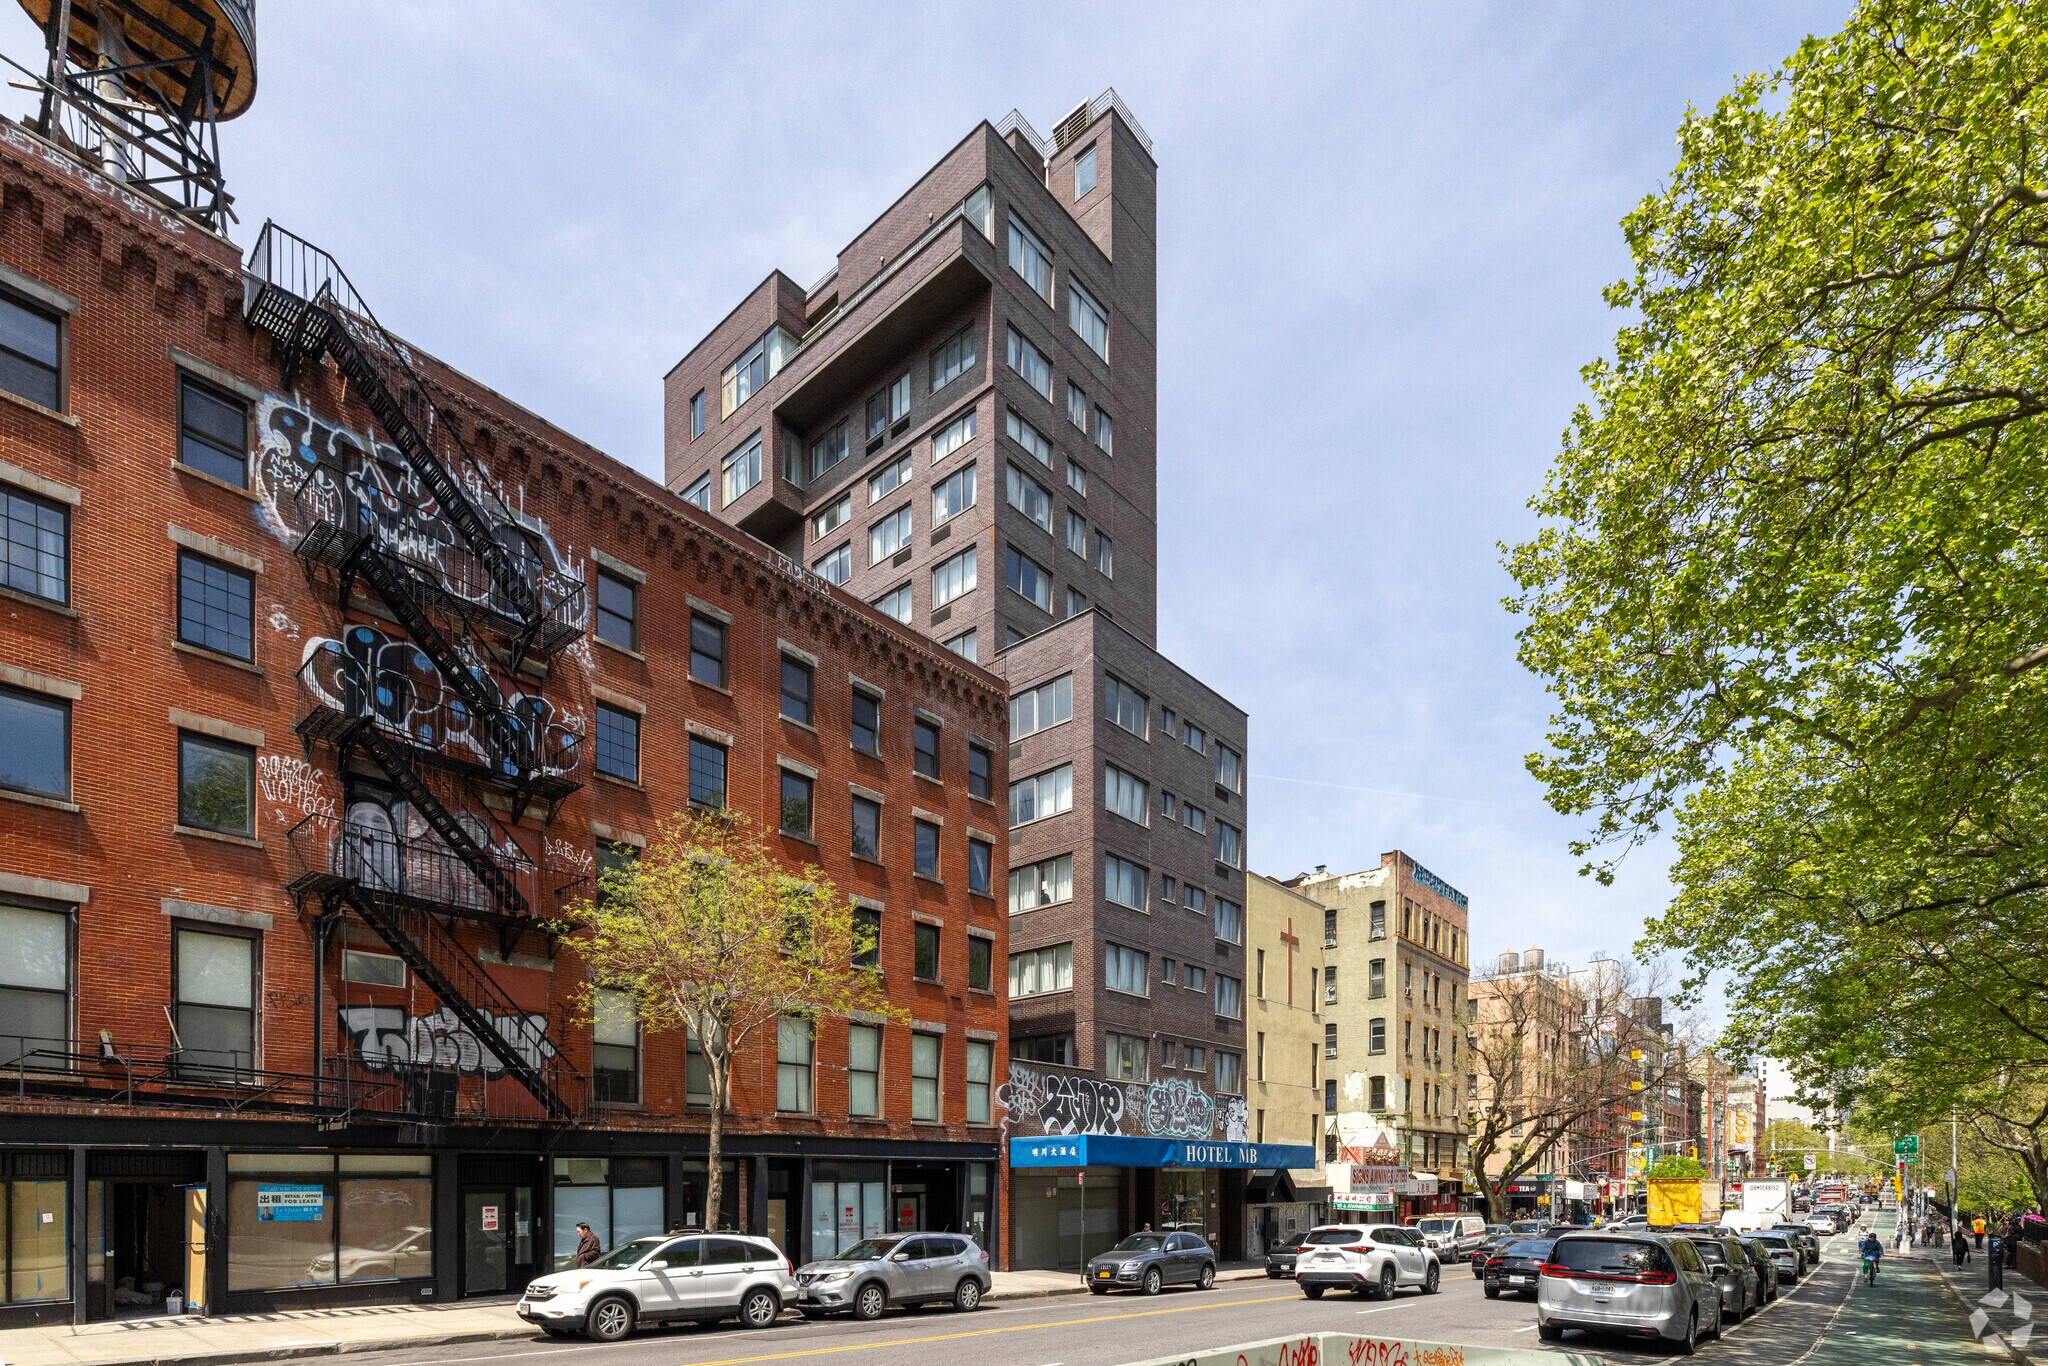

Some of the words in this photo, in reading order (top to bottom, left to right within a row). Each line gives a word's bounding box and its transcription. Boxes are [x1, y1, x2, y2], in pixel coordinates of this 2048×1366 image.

[1186, 1145, 1232, 1163] HOTEL
[1239, 1147, 1258, 1164] MB
[1352, 1168, 1369, 1184] SIGNS
[1370, 1168, 1393, 1184] AWNINGS
[1394, 1168, 1408, 1183] LETTERS
[260, 1194, 281, 1204] 出租
